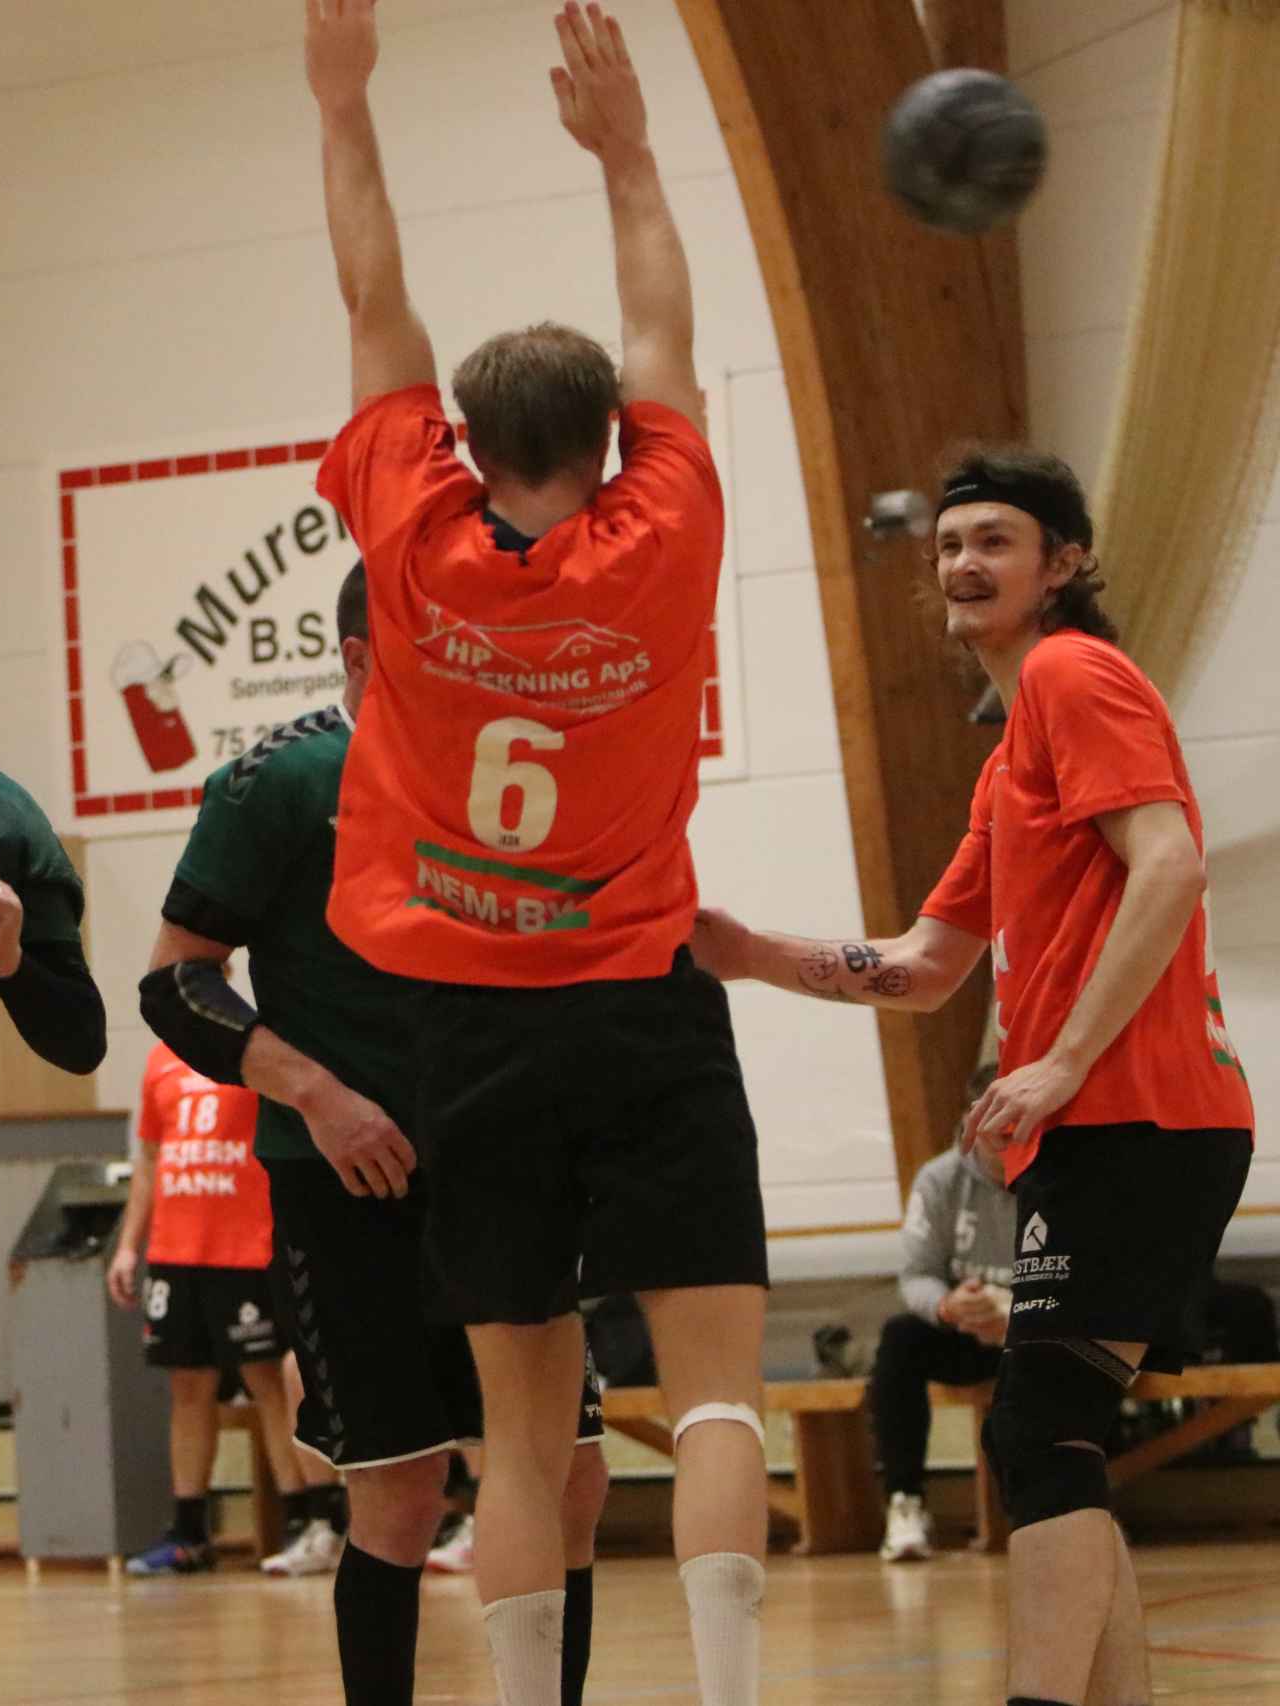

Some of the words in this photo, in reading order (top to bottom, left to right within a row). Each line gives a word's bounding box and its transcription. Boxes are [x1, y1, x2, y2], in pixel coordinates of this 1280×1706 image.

[445, 636, 493, 667] HP
[600, 651, 652, 685] ApS
[467, 716, 565, 853] 6
[175, 1094, 221, 1135] 18
